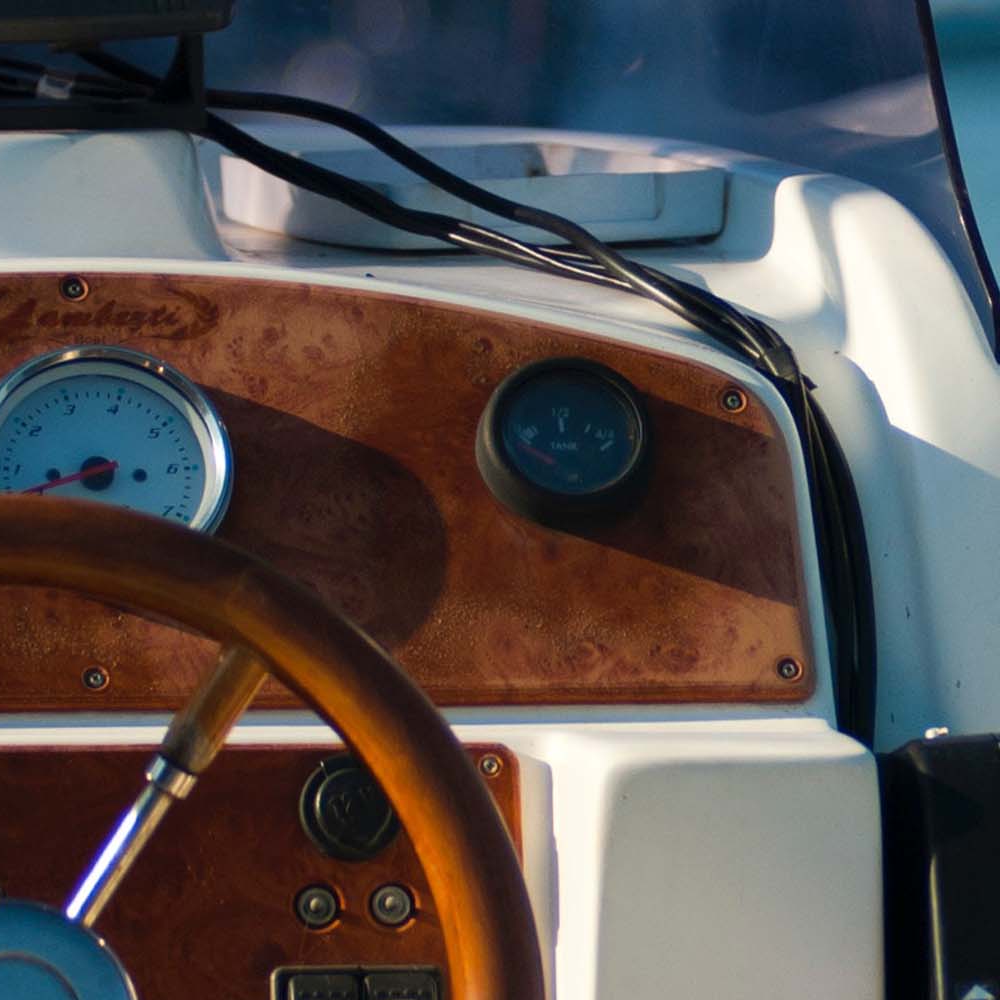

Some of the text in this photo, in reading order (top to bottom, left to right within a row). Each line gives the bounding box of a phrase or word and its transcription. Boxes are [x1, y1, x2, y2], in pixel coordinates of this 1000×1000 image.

[63, 404, 76, 416] 3
[106, 404, 120, 416] 4
[28, 426, 43, 438] 2
[147, 427, 162, 439] 5
[13, 462, 22, 476] 1
[165, 462, 179, 475] 6
[161, 504, 174, 518] 7
